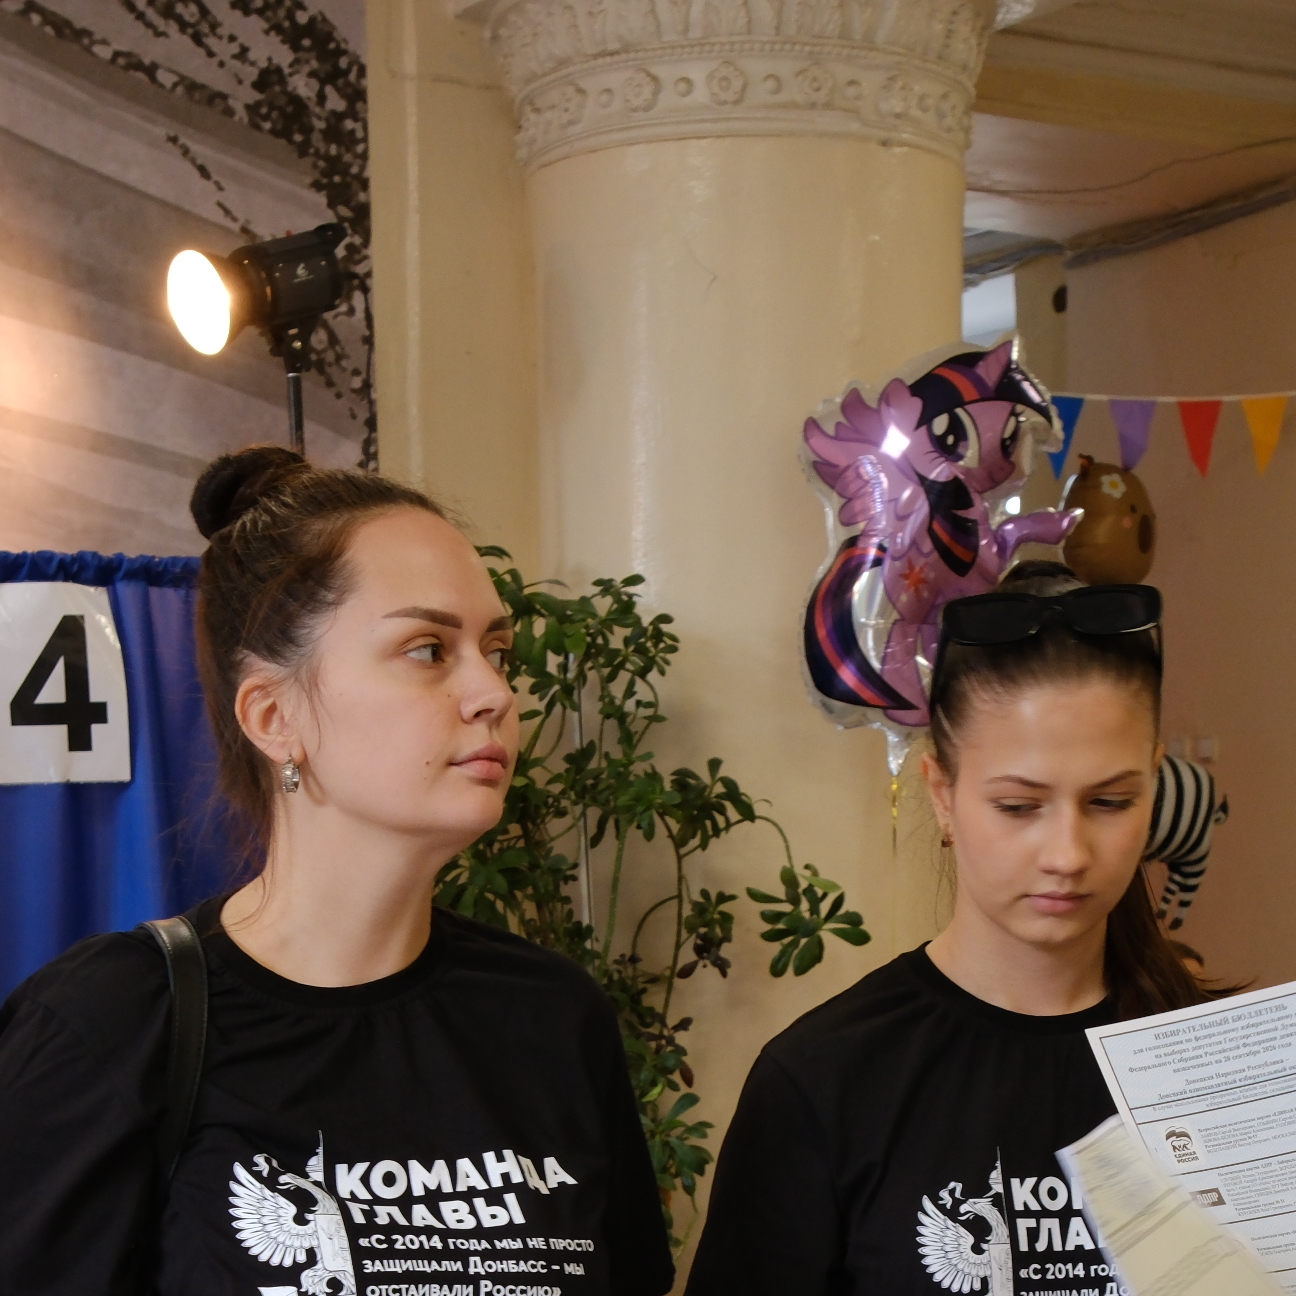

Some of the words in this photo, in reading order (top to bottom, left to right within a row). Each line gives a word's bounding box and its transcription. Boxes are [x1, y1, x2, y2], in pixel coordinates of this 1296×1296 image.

[10, 614, 108, 752] 4
[1153, 1016, 1230, 1041] ИЗБИРАТЕЛЬНЫЙ
[1230, 1002, 1288, 1023] БЮЛЛЕТЕНЬ
[1131, 1047, 1144, 1056] для
[1144, 1038, 1184, 1053] голосования
[1193, 1025, 1239, 1042] федеральному
[1127, 1058, 1172, 1076] Федерального
[1171, 1050, 1204, 1065] Собрания
[1203, 1042, 1241, 1058] Российской
[1183, 1073, 1215, 1088] Донецкая
[1214, 1066, 1246, 1081] Народная
[1246, 1057, 1284, 1073] Республика
[1156, 1088, 1187, 1102] Донецкий
[1187, 1076, 1237, 1095] одномандатный
[1237, 1065, 1287, 1083] избирательный
[335, 1149, 578, 1200] КОМАНДА
[345, 1192, 526, 1230] ГЛАВЫ
[358, 1234, 388, 1249] «С
[391, 1234, 443, 1249] 2014
[1016, 1217, 1106, 1252] ГЛА
[1019, 1263, 1042, 1280] «С
[1045, 1262, 1085, 1279] 2014
